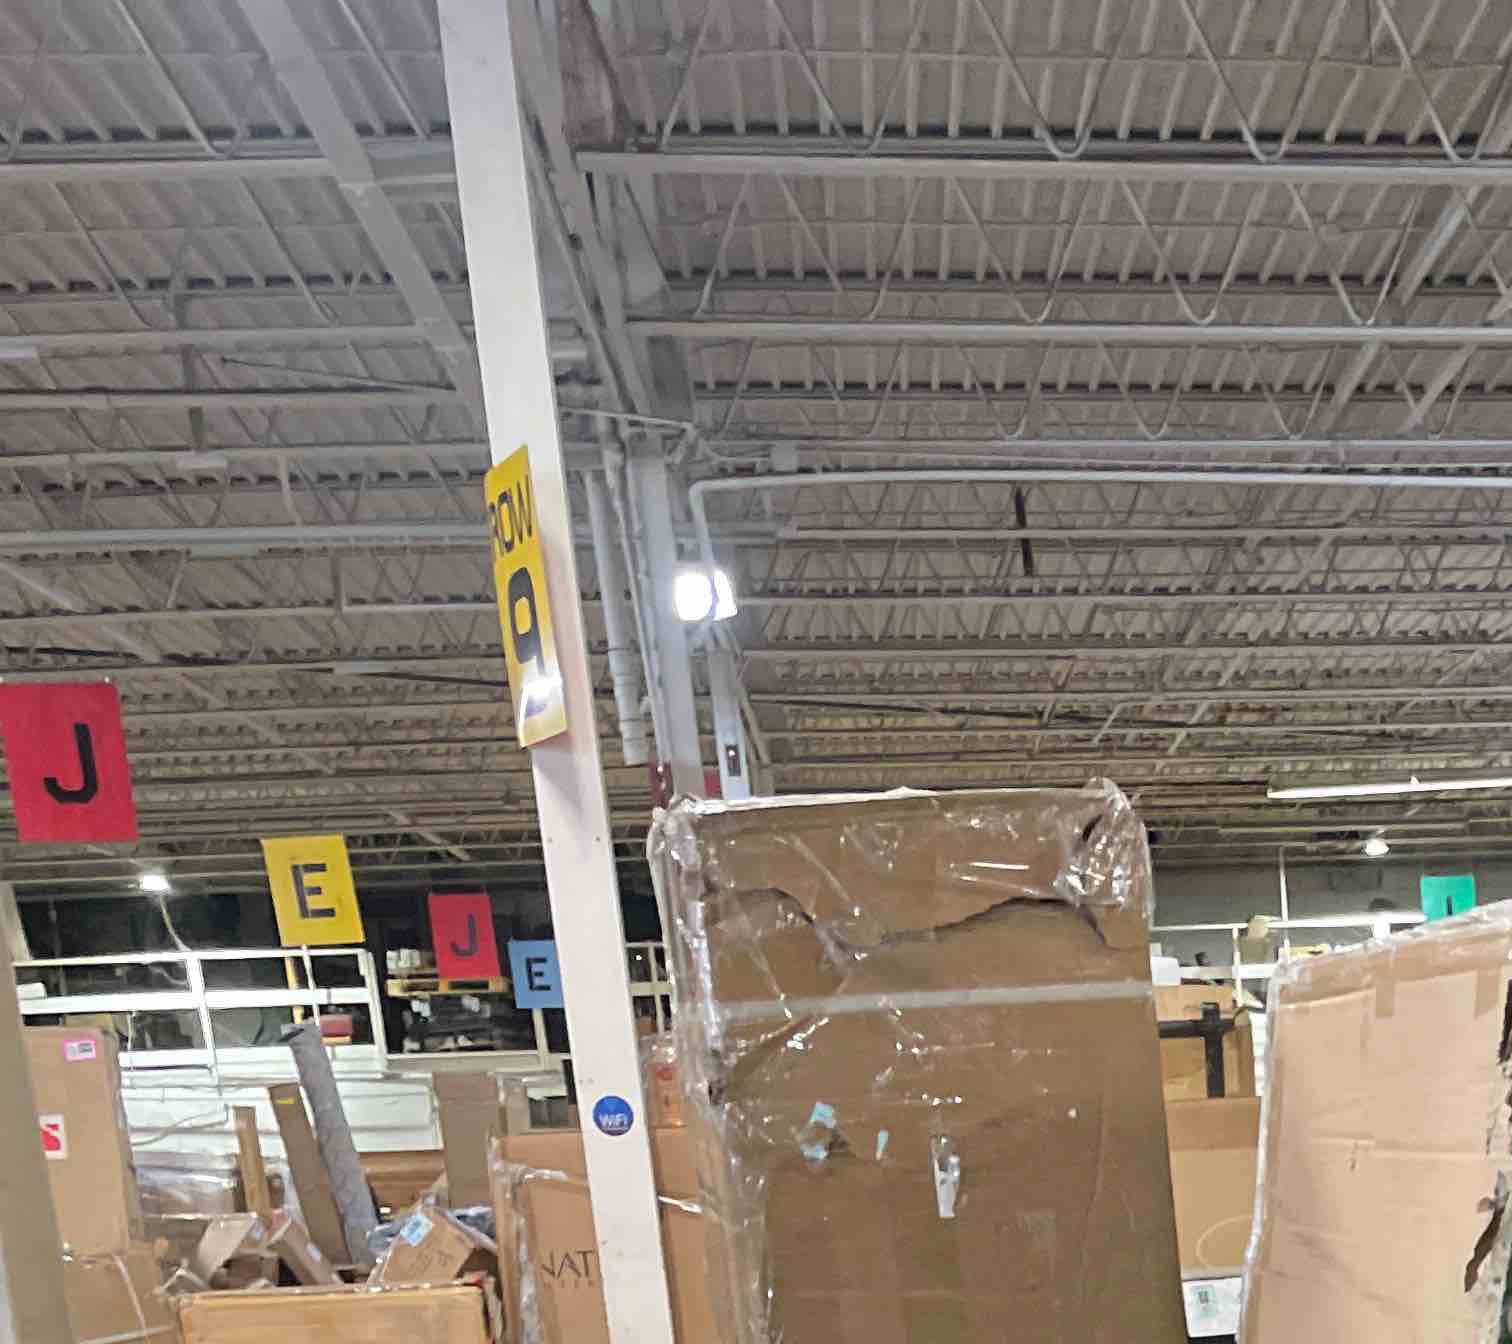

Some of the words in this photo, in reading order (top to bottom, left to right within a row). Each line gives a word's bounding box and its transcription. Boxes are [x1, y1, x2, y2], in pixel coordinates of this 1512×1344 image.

[489, 475, 533, 556] ROW
[508, 566, 549, 720] 9
[44, 723, 98, 806] J
[292, 863, 337, 919] E
[449, 913, 478, 958] J
[527, 956, 551, 991] E
